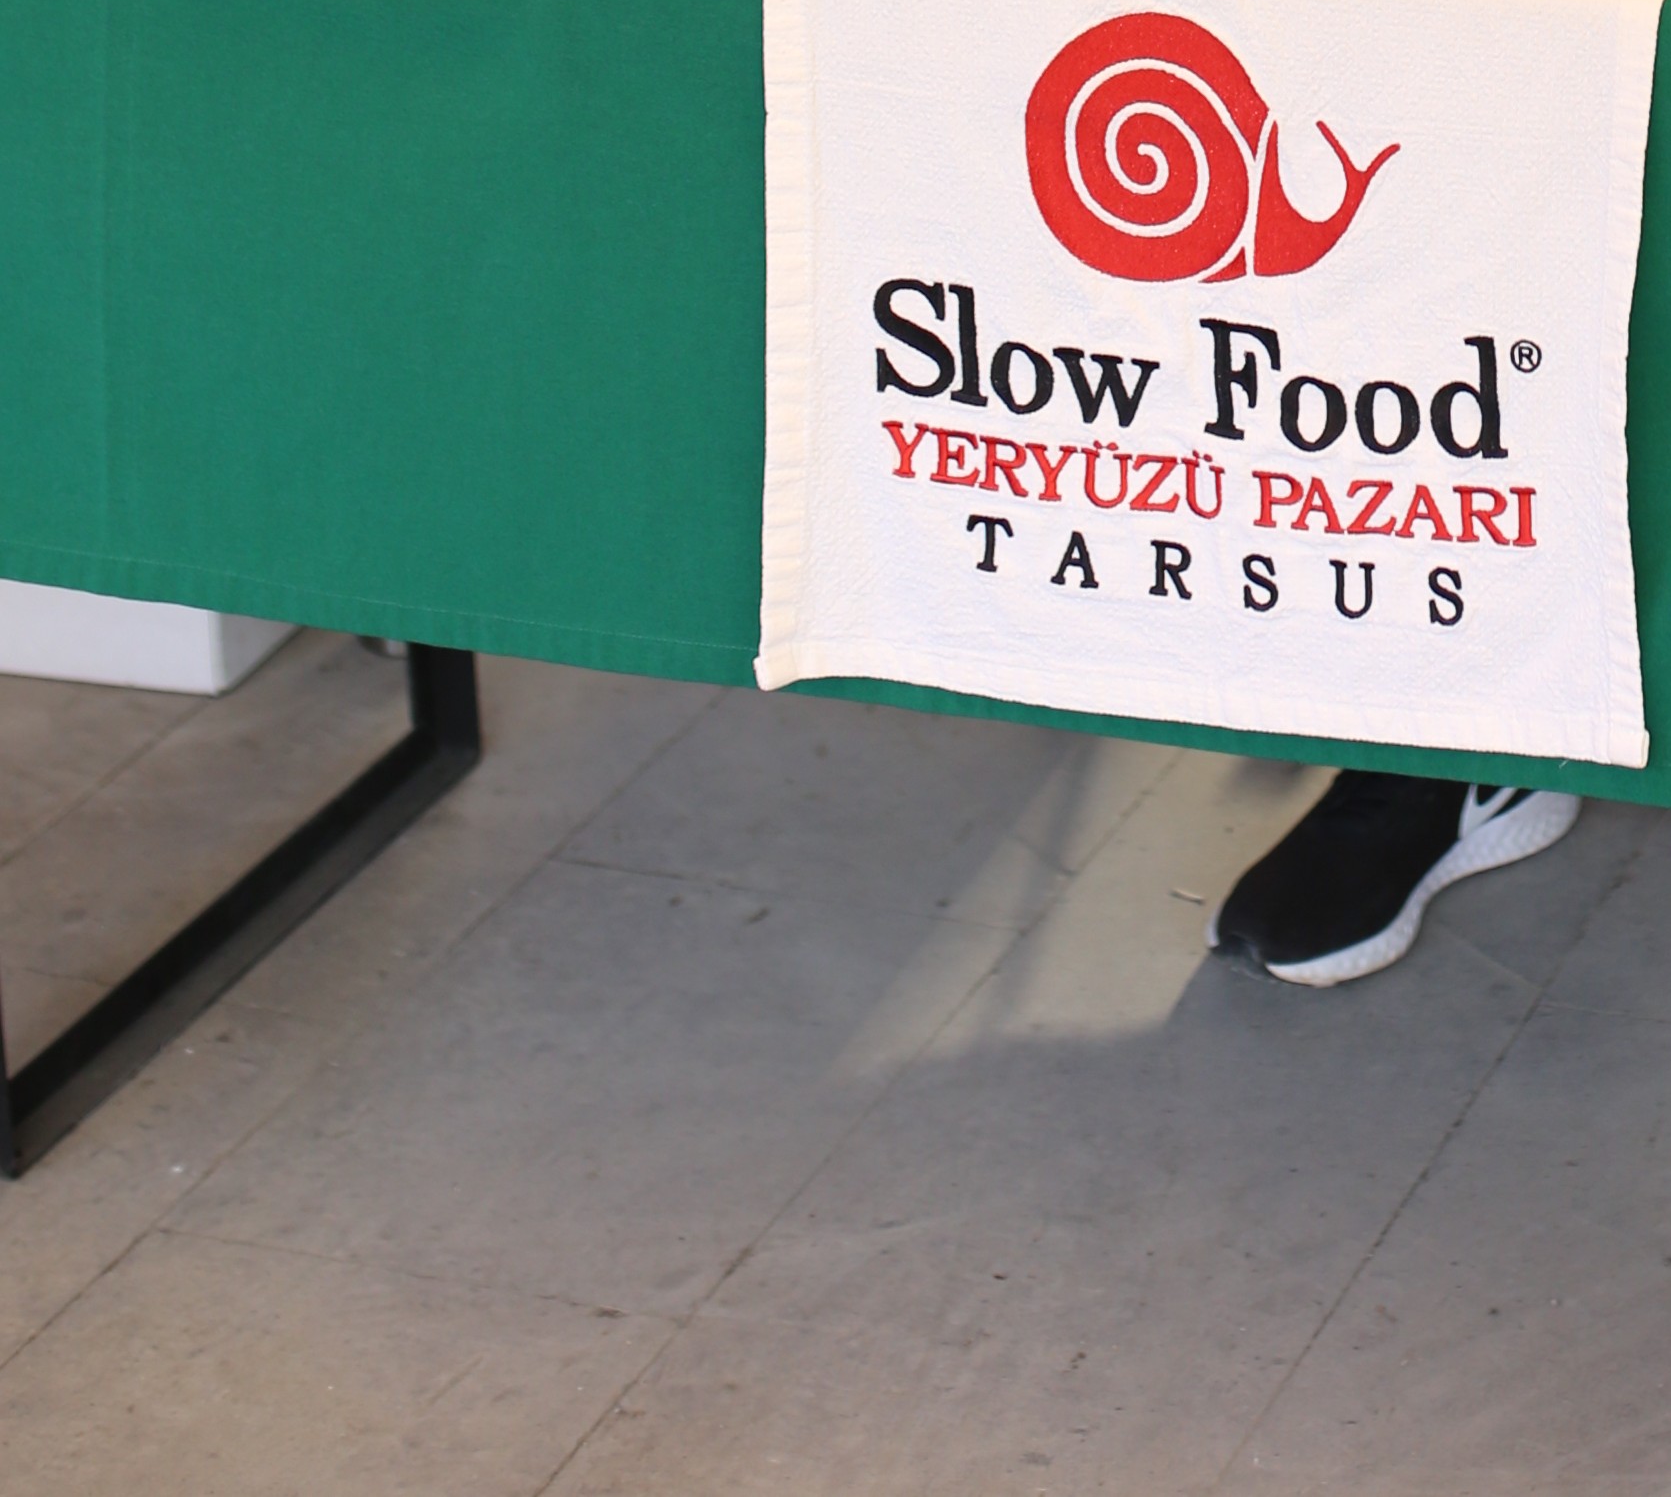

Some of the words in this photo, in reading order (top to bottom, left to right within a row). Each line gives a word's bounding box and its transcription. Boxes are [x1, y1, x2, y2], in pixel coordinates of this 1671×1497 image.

[873, 277, 1160, 428] Slow
[881, 420, 1225, 520] YERYÜZÜ
[1251, 469, 1538, 548] PAZARI
[965, 514, 1465, 627] TARSUS
